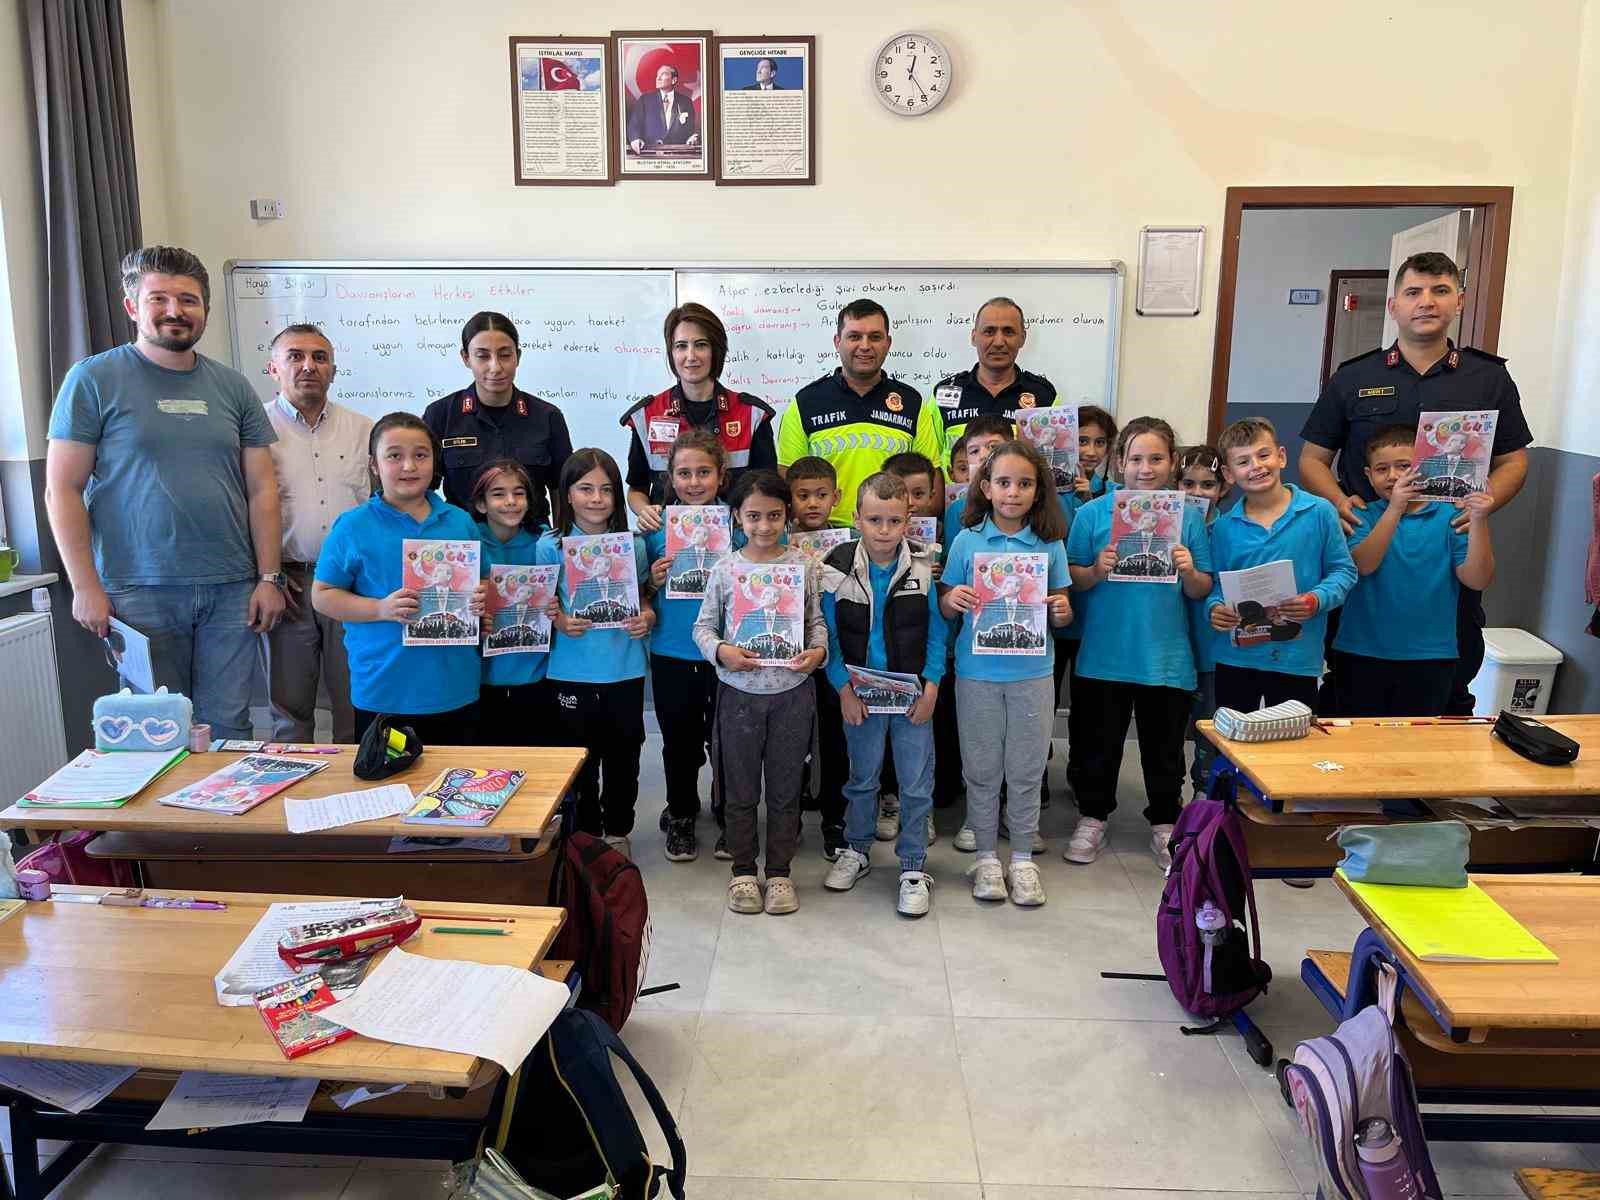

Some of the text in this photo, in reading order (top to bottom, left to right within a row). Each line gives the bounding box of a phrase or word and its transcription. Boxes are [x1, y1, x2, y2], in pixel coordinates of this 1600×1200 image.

[885, 56, 893, 64] 10
[930, 56, 937, 64] 2
[934, 70, 942, 78] 3
[930, 84, 937, 92] 4
[894, 94, 901, 103] 7
[907, 98, 915, 106] 6
[338, 312, 401, 328] tarafından
[414, 314, 466, 326] belirlenen
[543, 317, 577, 333] uygun
[587, 312, 626, 327] hareket
[372, 342, 403, 357] uygun
[588, 386, 618, 400] mutlu
[1511, 697, 1524, 707] 25
